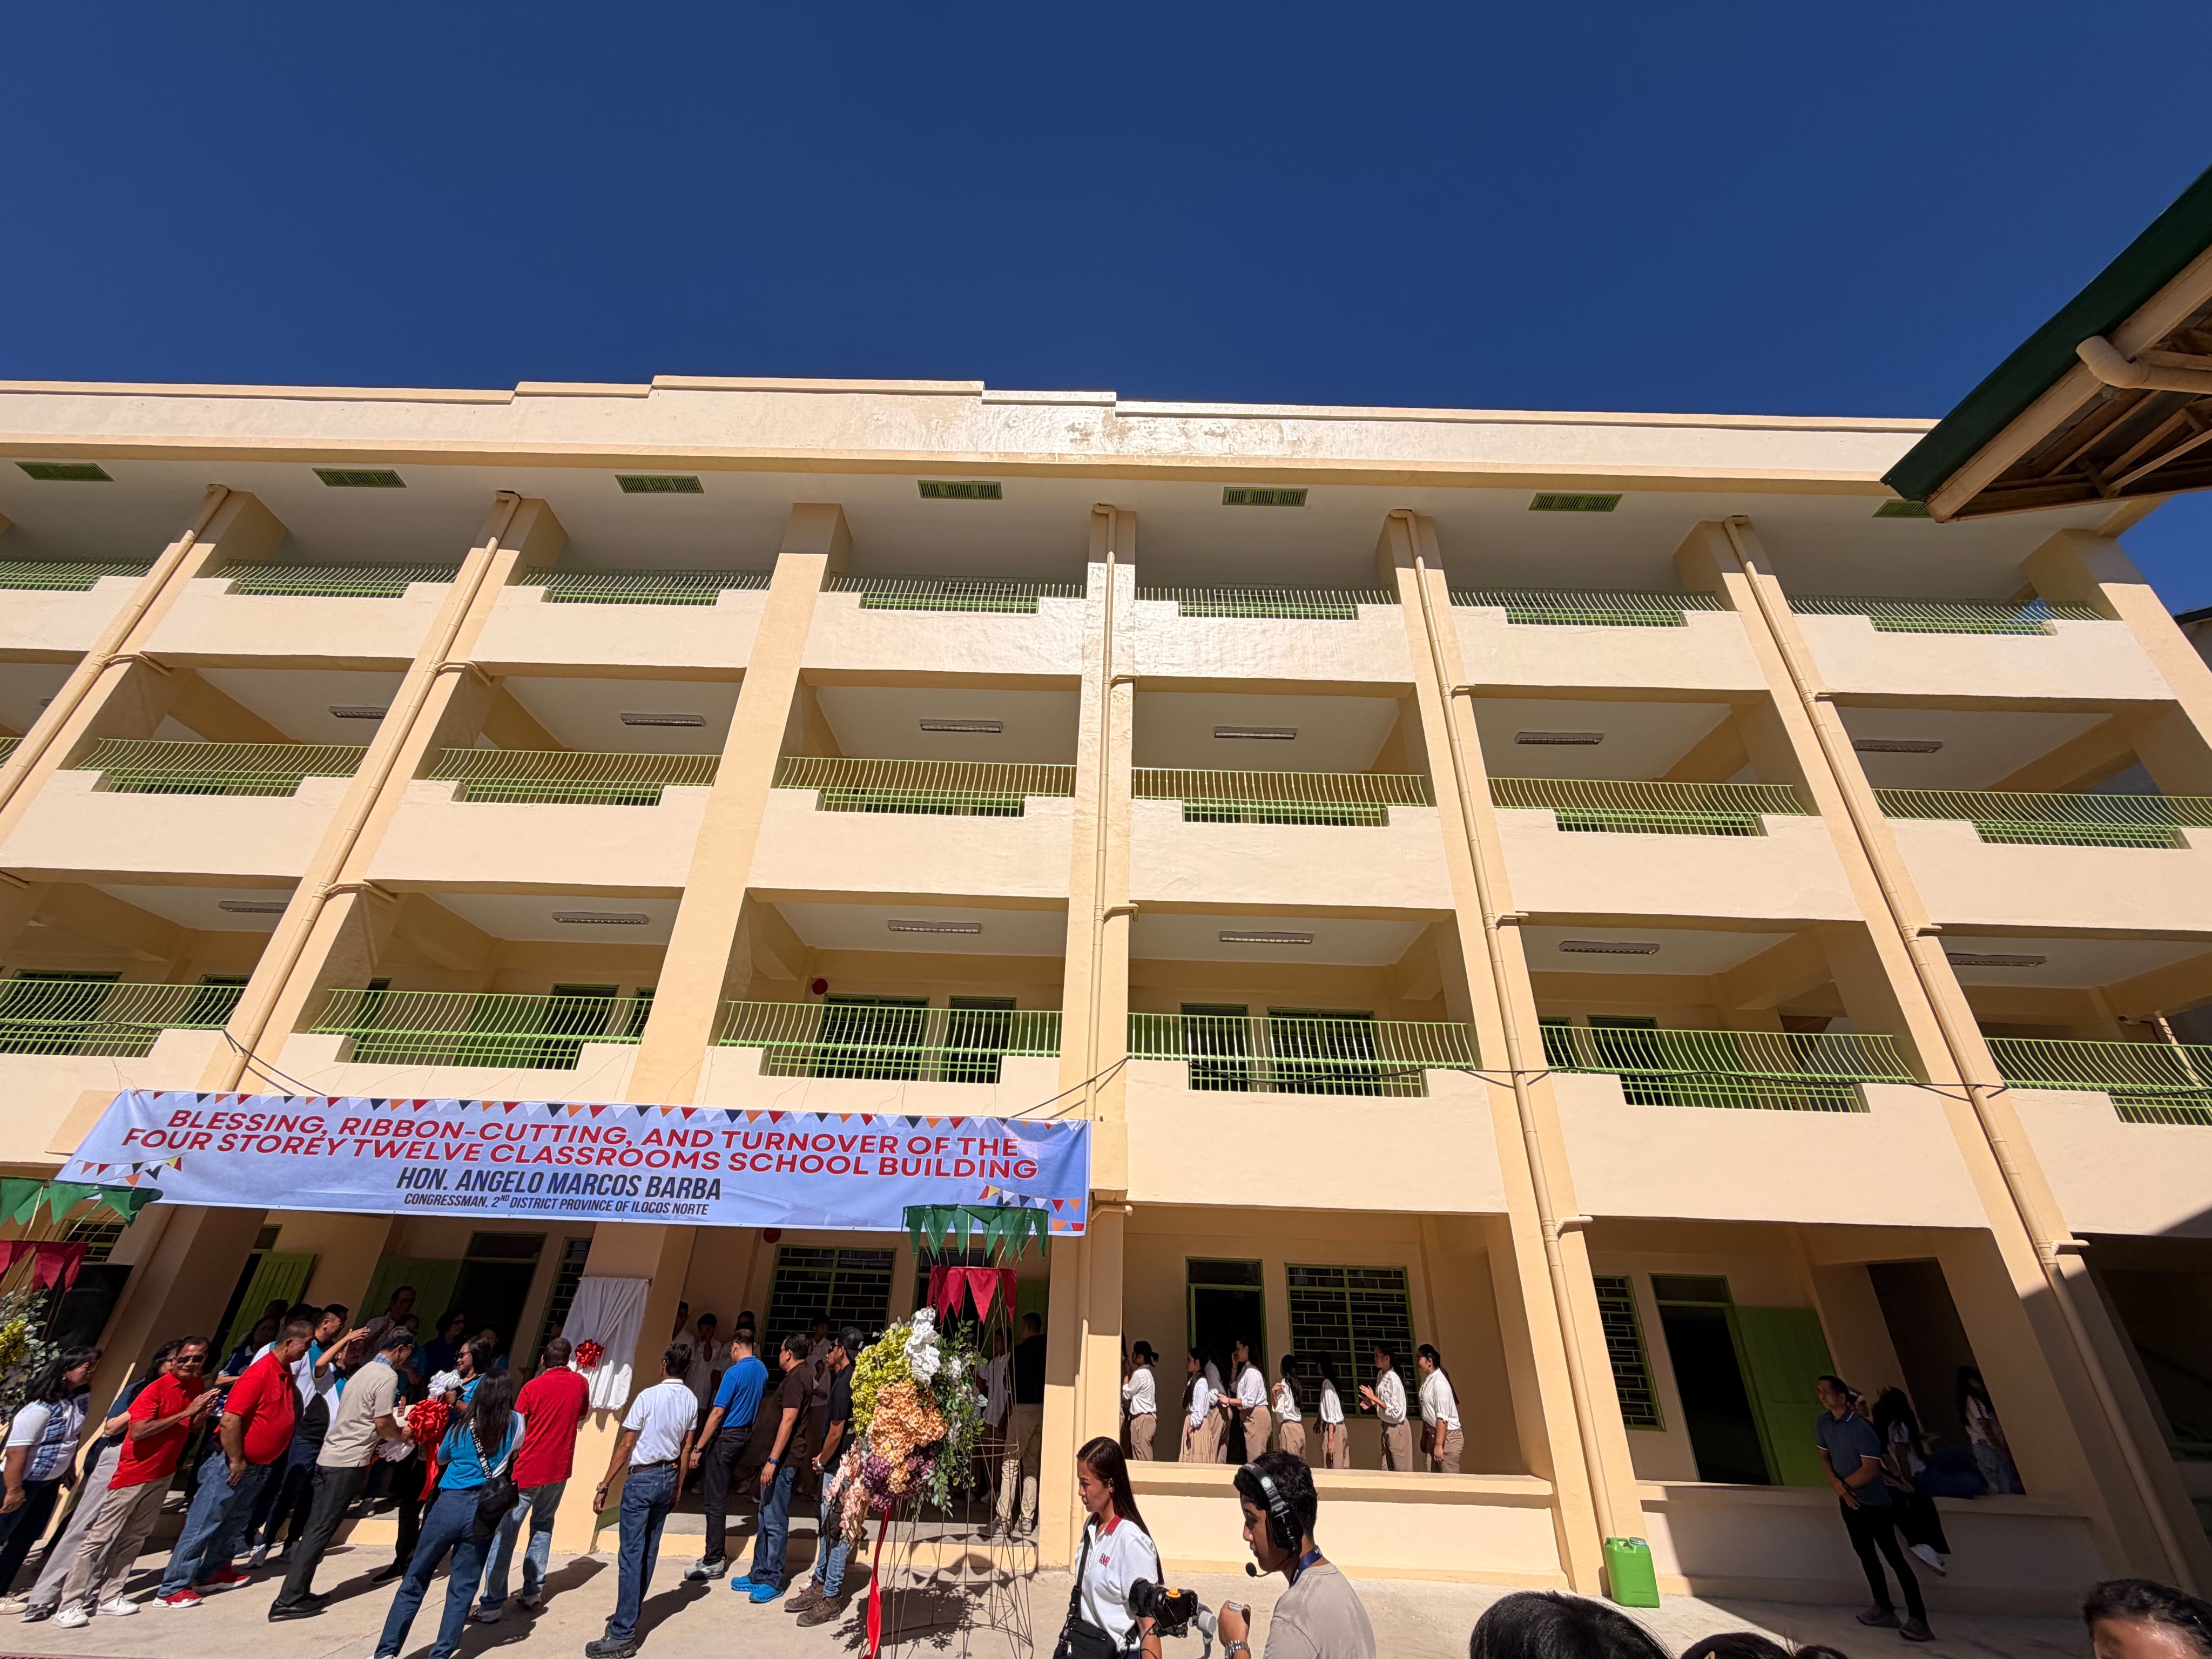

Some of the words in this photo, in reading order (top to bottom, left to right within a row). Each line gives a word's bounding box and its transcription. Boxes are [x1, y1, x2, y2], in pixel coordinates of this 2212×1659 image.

[167, 1110, 328, 1139] BLESSING,
[339, 1118, 632, 1148] RIBBON-CUTTING,
[642, 1128, 713, 1148] AND
[722, 1131, 899, 1154] TURNOVER
[907, 1137, 950, 1155] OF
[957, 1138, 1017, 1157] THE
[122, 1129, 213, 1150] FOUR
[218, 1134, 346, 1156] STOREY
[354, 1139, 483, 1162] TWELVE
[490, 1144, 720, 1171] CLASSROOMS
[729, 1152, 868, 1175] SCHOOL
[879, 1157, 1037, 1179] BUILDING
[396, 1167, 448, 1191] HON.
[455, 1169, 544, 1194] ANGELO
[547, 1172, 642, 1197] MARCOS
[645, 1176, 720, 1201] BARBA
[404, 1193, 488, 1209] CONGRESSMAN,
[509, 1197, 558, 1210] DISTRICT
[559, 1198, 613, 1212] PROVINCE
[615, 1201, 630, 1212] OF
[631, 1201, 671, 1214] ILOCOS
[672, 1203, 709, 1215] NORTE
